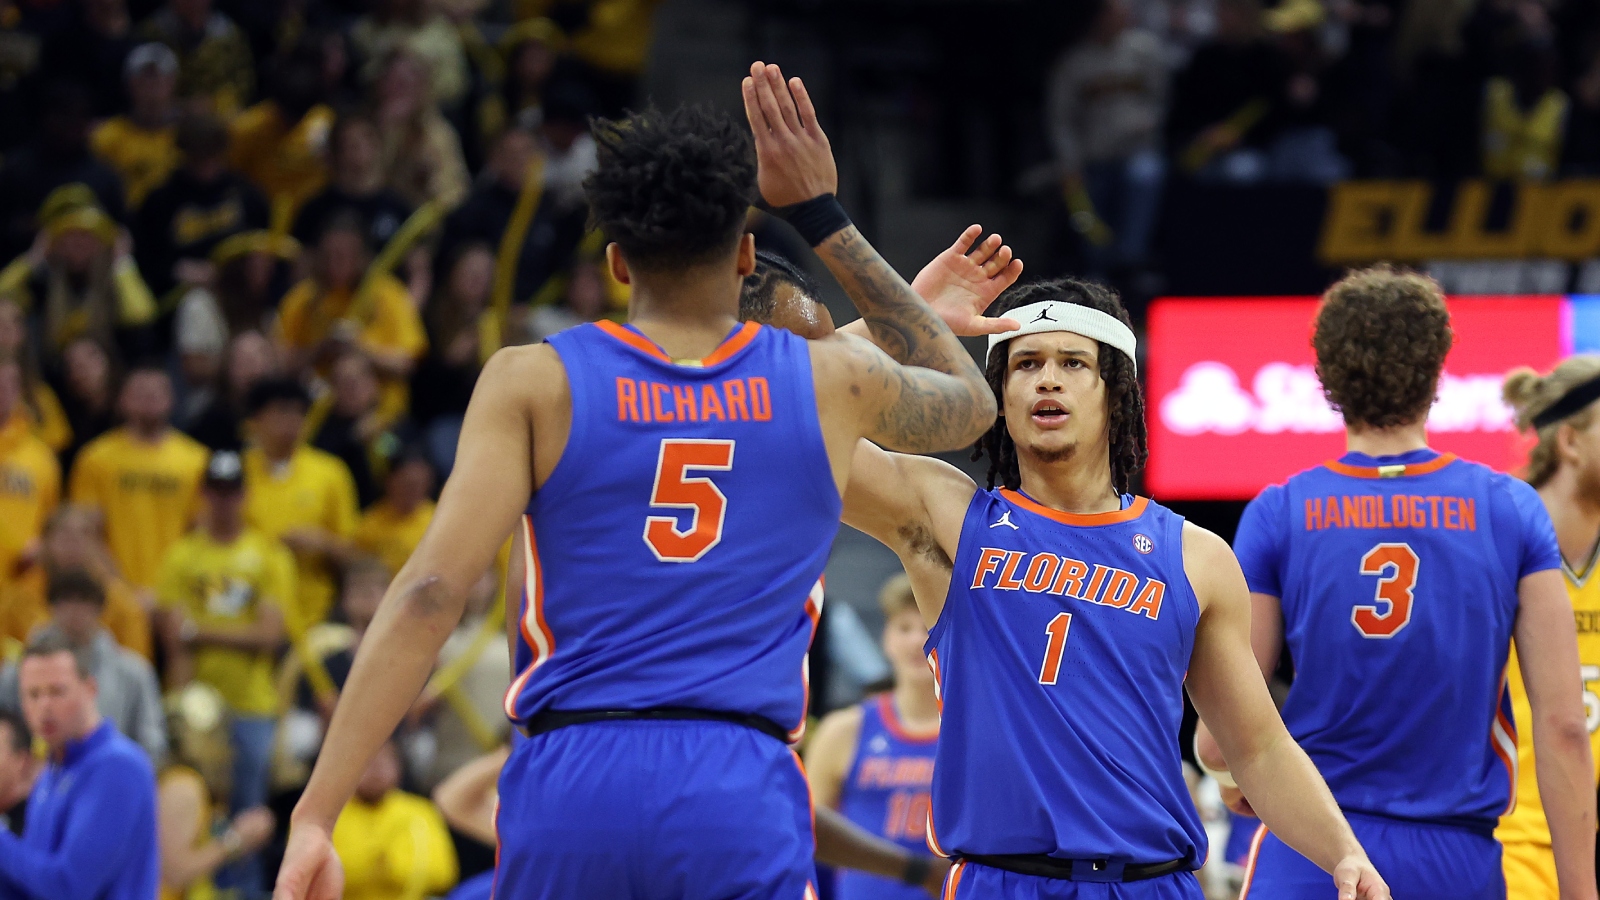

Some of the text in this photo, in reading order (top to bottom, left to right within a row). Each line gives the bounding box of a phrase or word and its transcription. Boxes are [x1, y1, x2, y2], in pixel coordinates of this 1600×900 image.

[615, 376, 773, 423] RICHARD
[642, 438, 736, 563] 5
[1305, 494, 1477, 532] HANDLOGTEN
[1134, 535, 1152, 553] SEC
[969, 547, 1166, 621] FLORIDA
[1350, 542, 1420, 639] 3
[1038, 612, 1072, 686] 1
